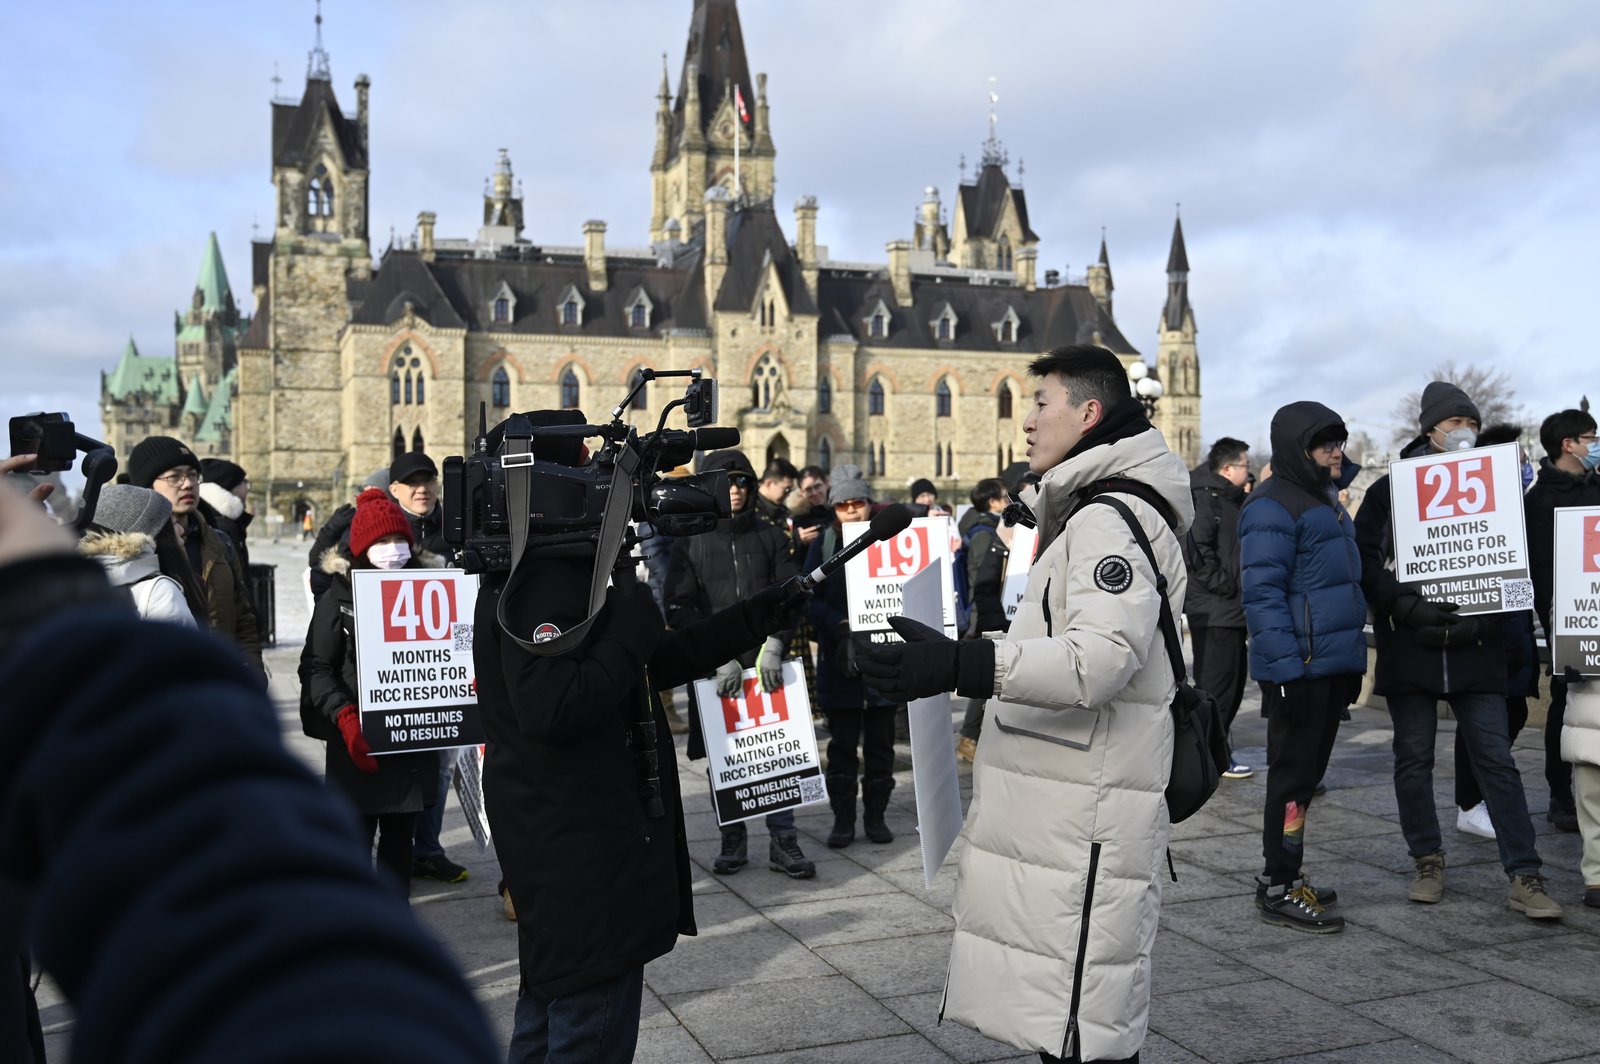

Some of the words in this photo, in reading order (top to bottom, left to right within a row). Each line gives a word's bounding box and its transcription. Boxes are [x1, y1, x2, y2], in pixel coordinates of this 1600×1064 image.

[1424, 459, 1487, 519] 25
[1427, 520, 1488, 539] MONTHS
[874, 528, 921, 576] 19
[1413, 539, 1473, 558] WAITING
[1477, 534, 1506, 550] FOR
[1406, 560, 1437, 575] IRCC
[1439, 550, 1517, 571] RESPONSE
[1421, 583, 1438, 596] NO
[1440, 576, 1503, 593] TIMELINES
[1447, 591, 1499, 605] RESULTS
[390, 580, 450, 640] 40
[858, 612, 884, 624] IRCC
[1564, 616, 1598, 629] IRCC
[871, 633, 885, 643] NO
[1580, 640, 1598, 652] NO
[392, 649, 451, 665] MONTHS
[378, 668, 436, 684] WAITING
[441, 666, 467, 680] FOR
[370, 688, 401, 703] IRCC
[403, 684, 476, 701] RESPONSE
[732, 684, 780, 731] 11
[385, 715, 402, 728] NO
[404, 710, 463, 727] TIMELINES
[391, 730, 407, 743] NO
[410, 725, 459, 741] RESULTS
[735, 728, 785, 750] MONTHS
[724, 745, 775, 767] WAITING
[778, 740, 801, 755] FOR
[720, 767, 747, 784] IRCC
[748, 752, 810, 776] RESPONSE
[735, 787, 750, 800] NO
[751, 775, 802, 797] TIMELINES
[742, 798, 757, 811] NO
[758, 788, 800, 807] RESULTS
